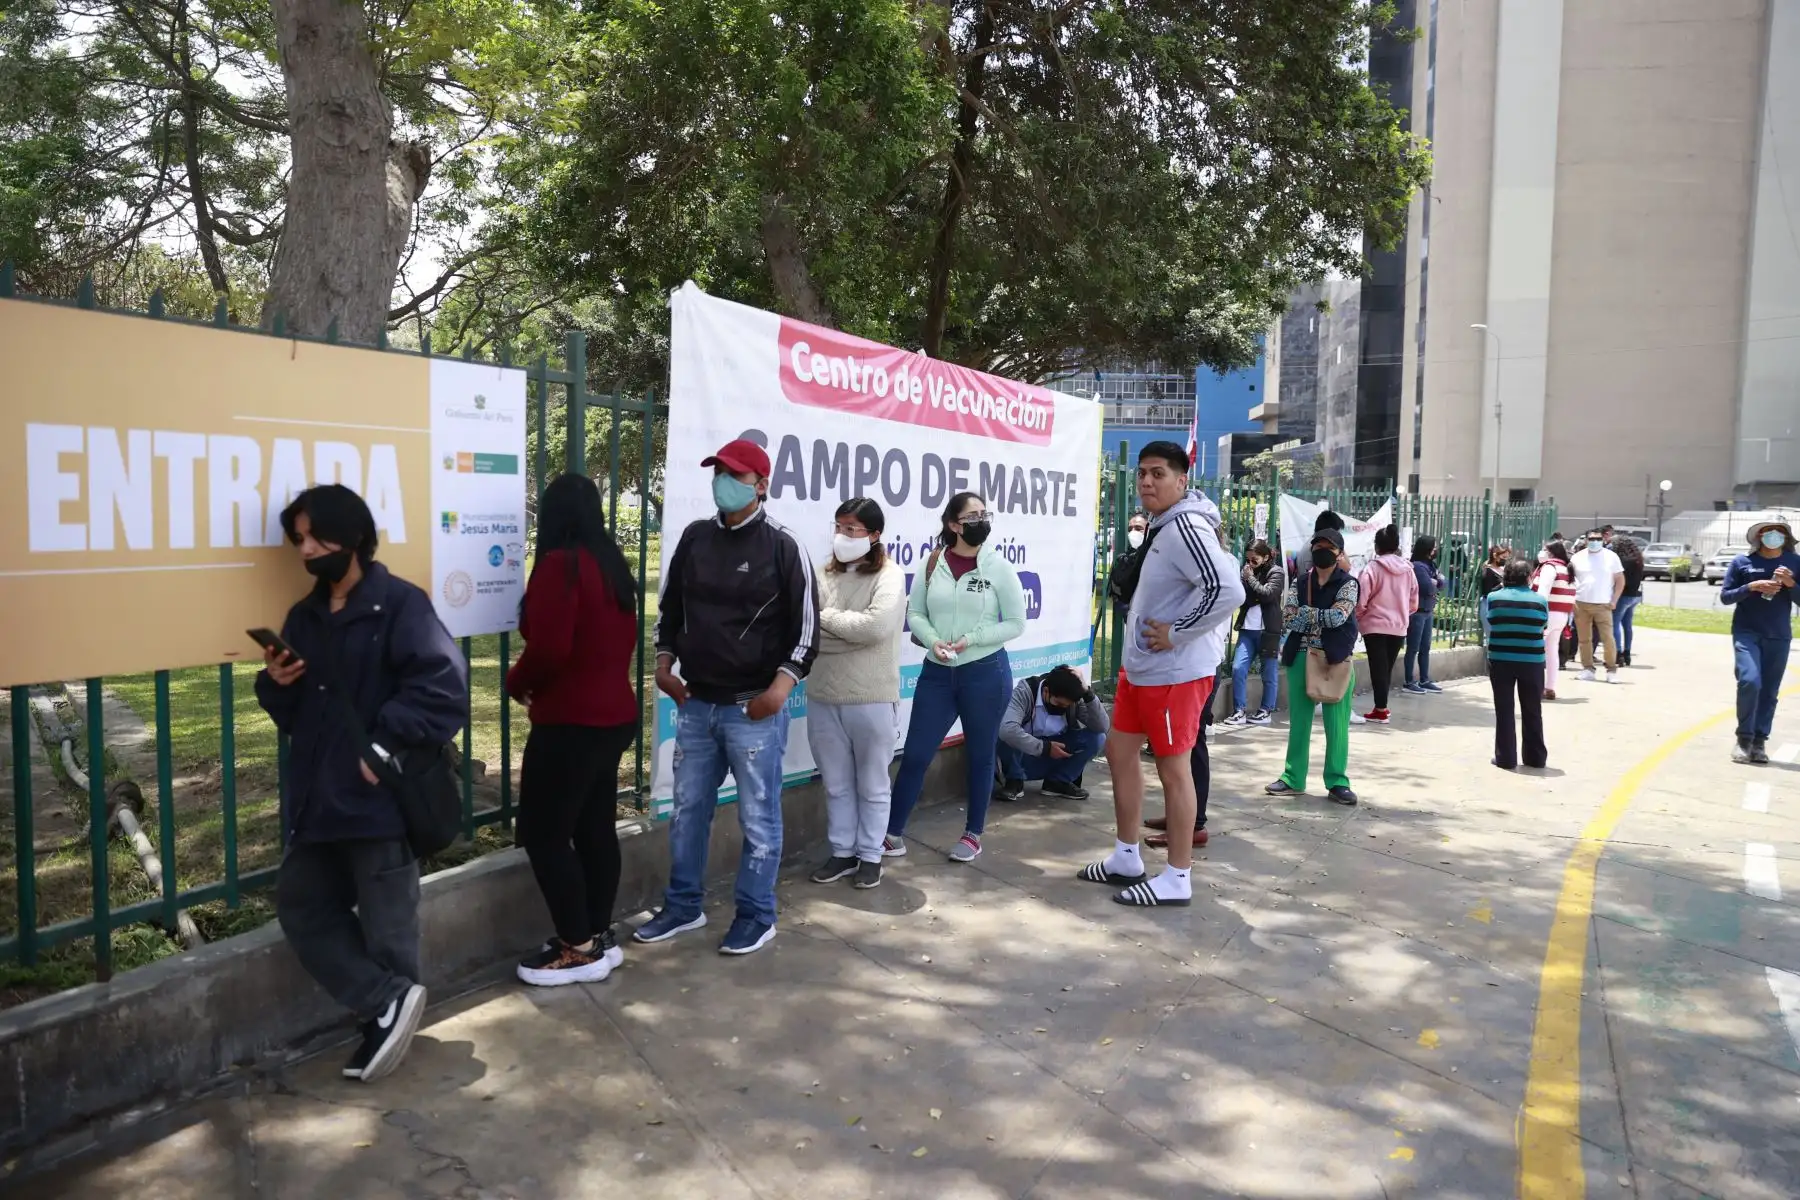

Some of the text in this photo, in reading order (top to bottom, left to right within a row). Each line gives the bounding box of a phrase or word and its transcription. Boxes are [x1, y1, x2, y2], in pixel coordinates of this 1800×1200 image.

[790, 341, 1048, 430] Centro de Vacunación
[921, 453, 969, 509] DE
[979, 461, 1077, 517] MARTE
